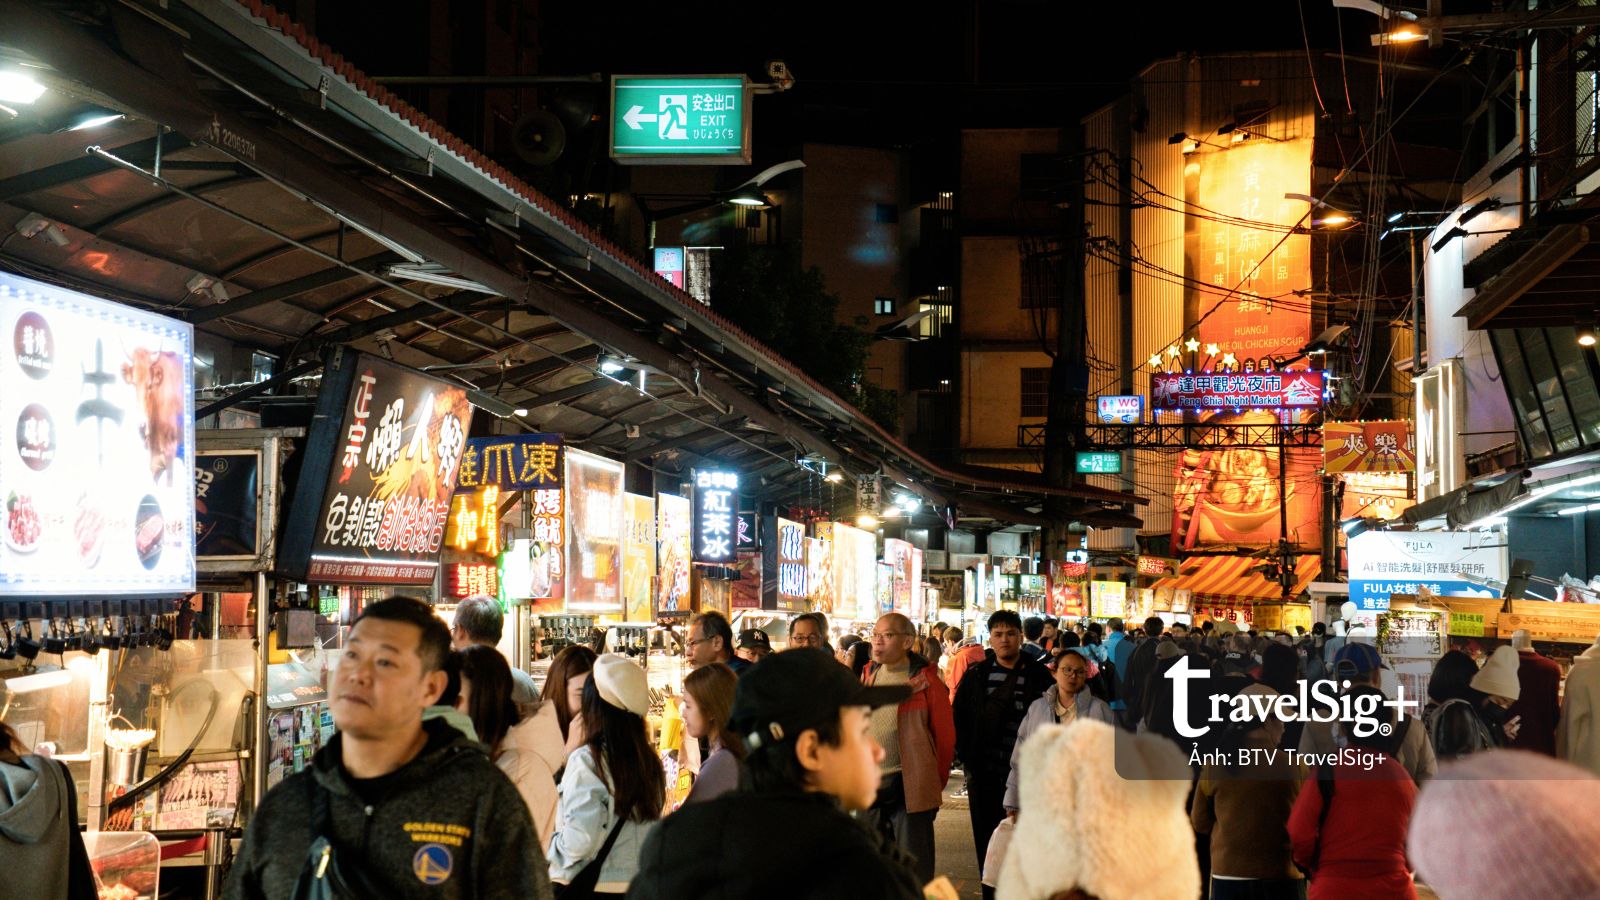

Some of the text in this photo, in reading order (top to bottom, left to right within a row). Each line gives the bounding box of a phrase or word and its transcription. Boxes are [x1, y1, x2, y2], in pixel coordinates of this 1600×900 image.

[692, 93, 735, 111] 安全出口
[700, 114, 727, 126] EXIT
[693, 129, 734, 139] ひじょうぐち
[1234, 325, 1268, 336] HUANGJI
[1231, 340, 1244, 350] OIL
[1245, 338, 1280, 349] CHICKEN
[1280, 336, 1304, 346] SOUP
[1178, 375, 1282, 393] 逢甲觀光夜市
[1118, 398, 1138, 407] WC
[1178, 397, 1200, 408] Feng
[1203, 396, 1223, 406] Chia
[1225, 395, 1249, 407] Night
[1251, 396, 1282, 405] Market
[342, 373, 377, 469] 正宗
[1342, 433, 1416, 456] 夾樂
[702, 489, 731, 558] 紅茶冰
[1405, 541, 1433, 551] FULA
[1363, 562, 1374, 572] Ai
[1363, 598, 1391, 610] 進去
